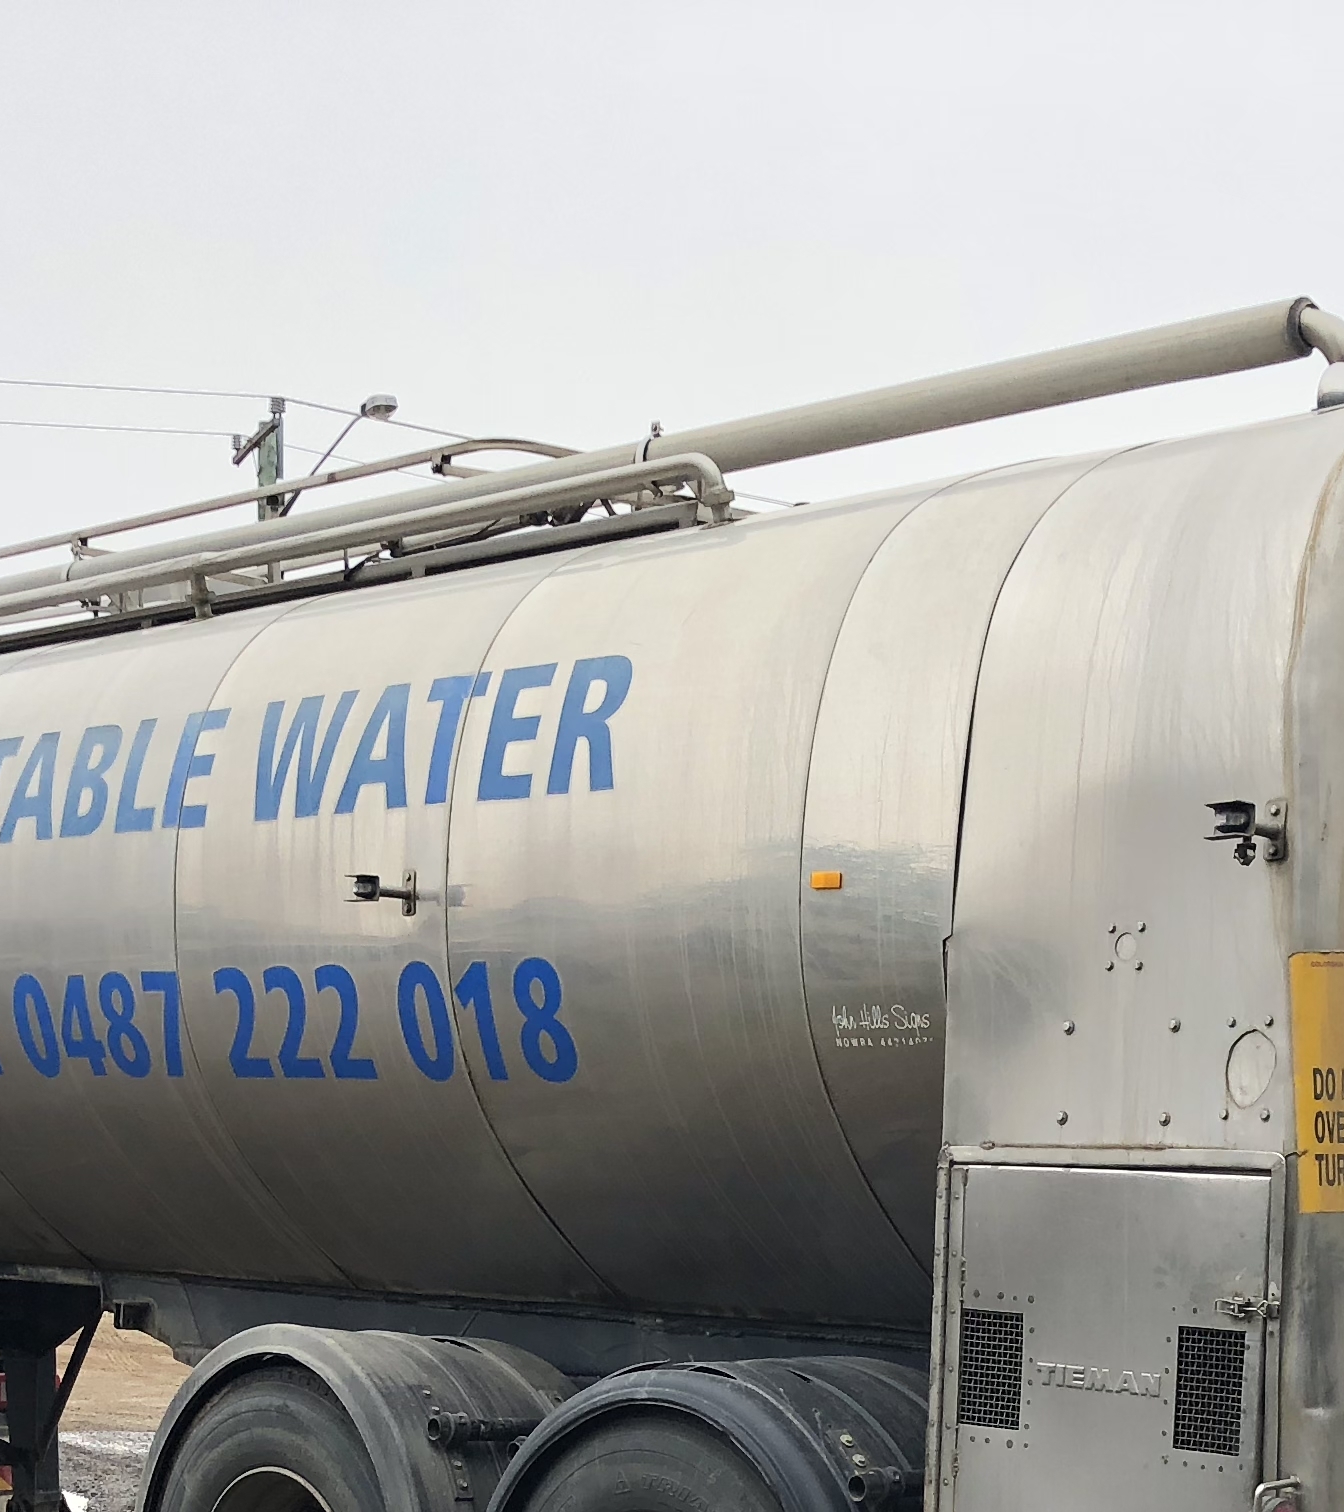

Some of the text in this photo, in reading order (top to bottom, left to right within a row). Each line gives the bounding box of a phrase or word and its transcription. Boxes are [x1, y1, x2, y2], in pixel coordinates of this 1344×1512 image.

[254, 654, 633, 823] WATER
[13, 970, 186, 1080] 0487
[213, 963, 378, 1083] 222
[396, 956, 579, 1085] 018
[832, 1003, 930, 1037] John Hills Signs
[836, 1037, 874, 1048] NOWRA
[1312, 1067, 1336, 1101] DO
[1036, 1361, 1161, 1398] TIEMAN
